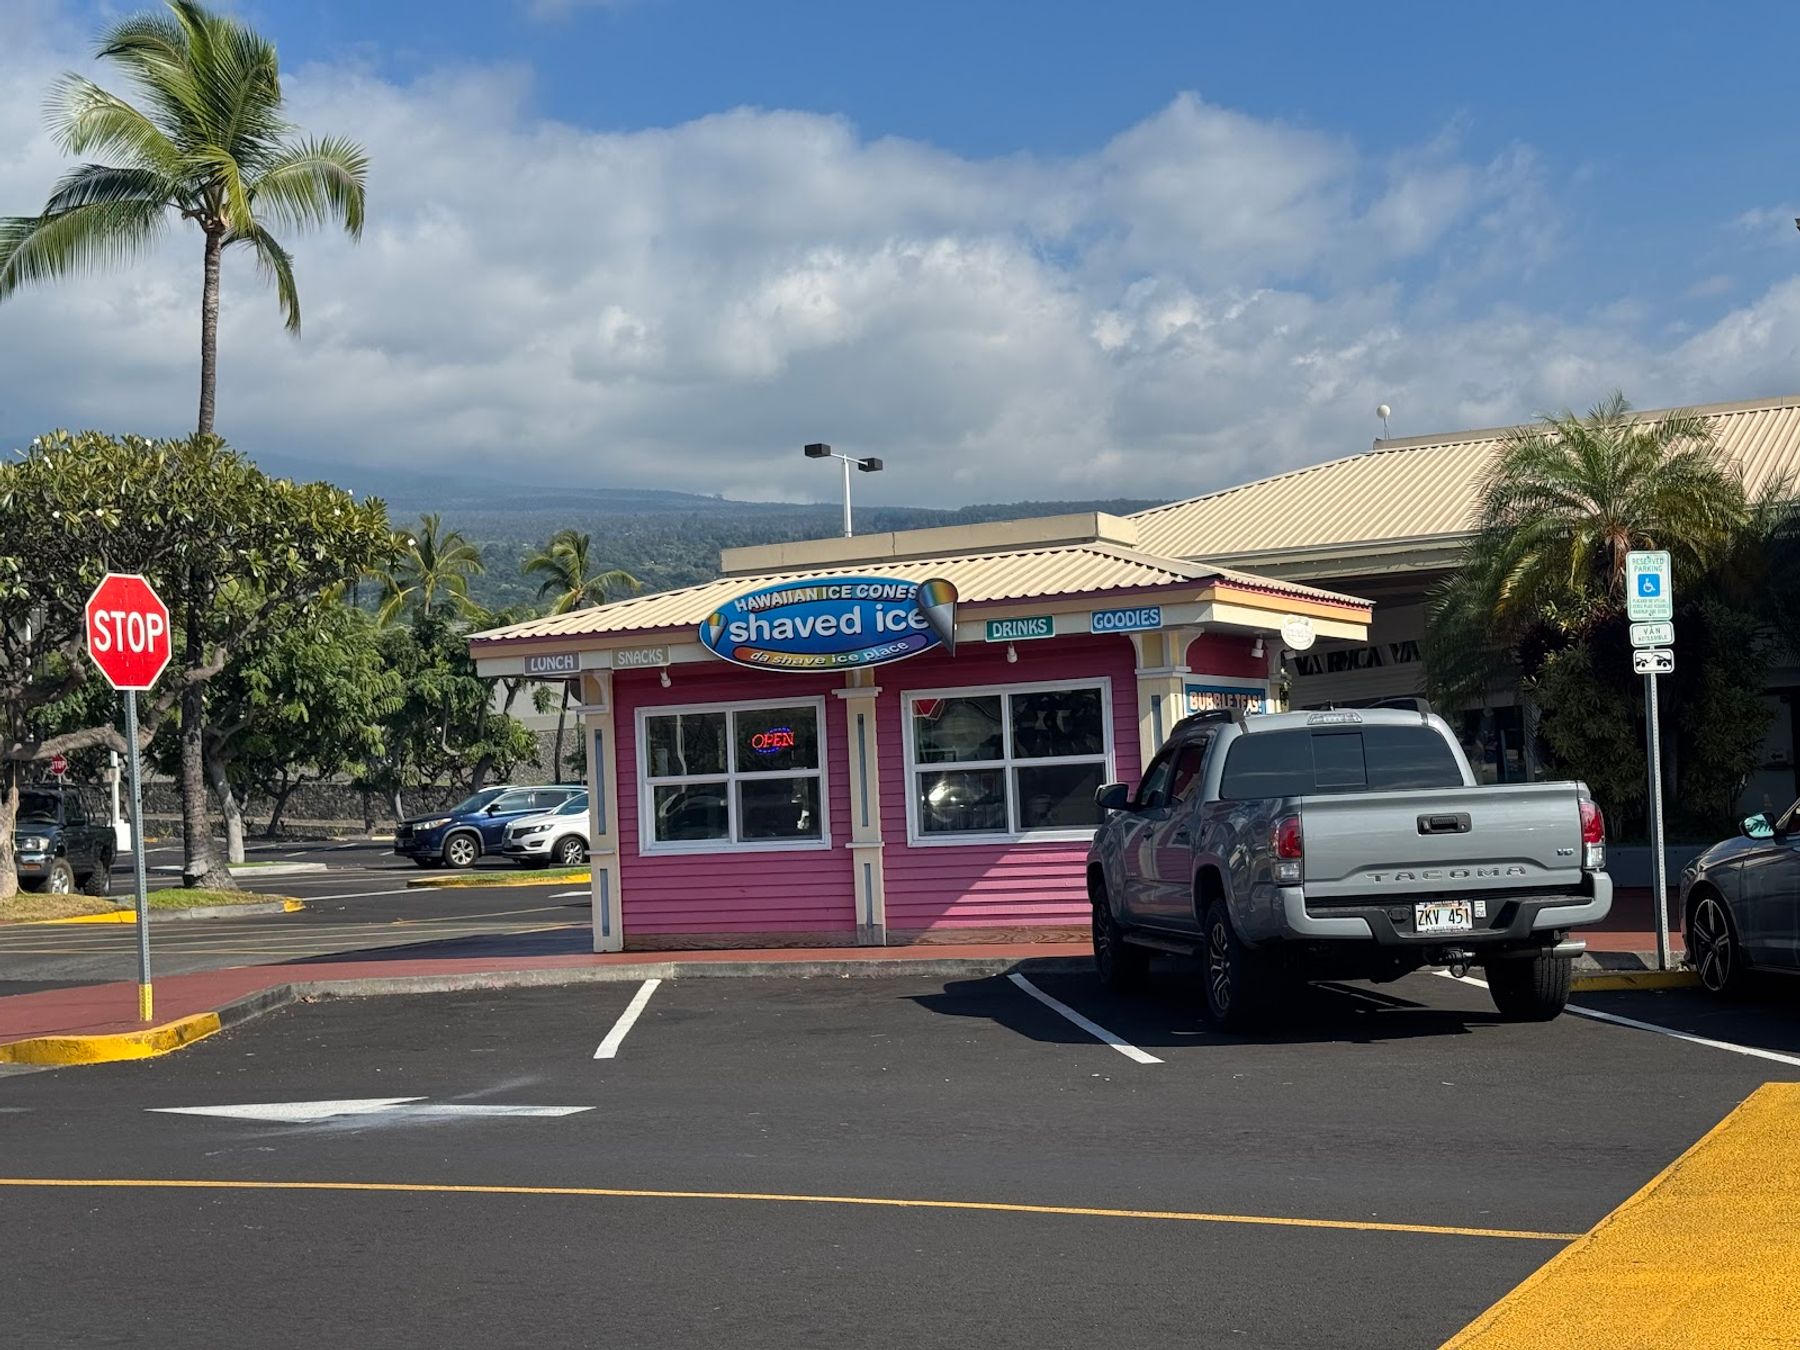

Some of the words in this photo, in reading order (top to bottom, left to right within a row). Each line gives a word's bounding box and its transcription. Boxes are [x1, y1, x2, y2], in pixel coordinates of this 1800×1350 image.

[1632, 557, 1664, 565] RESERVED
[1634, 565, 1663, 573] PARKING
[734, 588, 819, 613] HAWAIIAN
[822, 586, 852, 600] ICE
[856, 584, 919, 600] CONES
[729, 605, 862, 643] shaved
[875, 603, 930, 633] ice
[992, 618, 1048, 638] DRINKS
[1093, 609, 1159, 629] GOODIES
[93, 609, 164, 653] STOP
[1643, 627, 1661, 635] VAN
[617, 649, 664, 665] SNACKS
[750, 650, 769, 663] da
[771, 653, 826, 665] shave
[831, 653, 859, 664] ice
[863, 641, 909, 661] place
[530, 655, 574, 672] LUNCH
[1189, 691, 1233, 711] BUBBLE
[752, 732, 794, 748] OPEN
[1365, 866, 1527, 882] TACOMA
[1417, 909, 1440, 926] ZKV
[1448, 908, 1470, 925] 451
